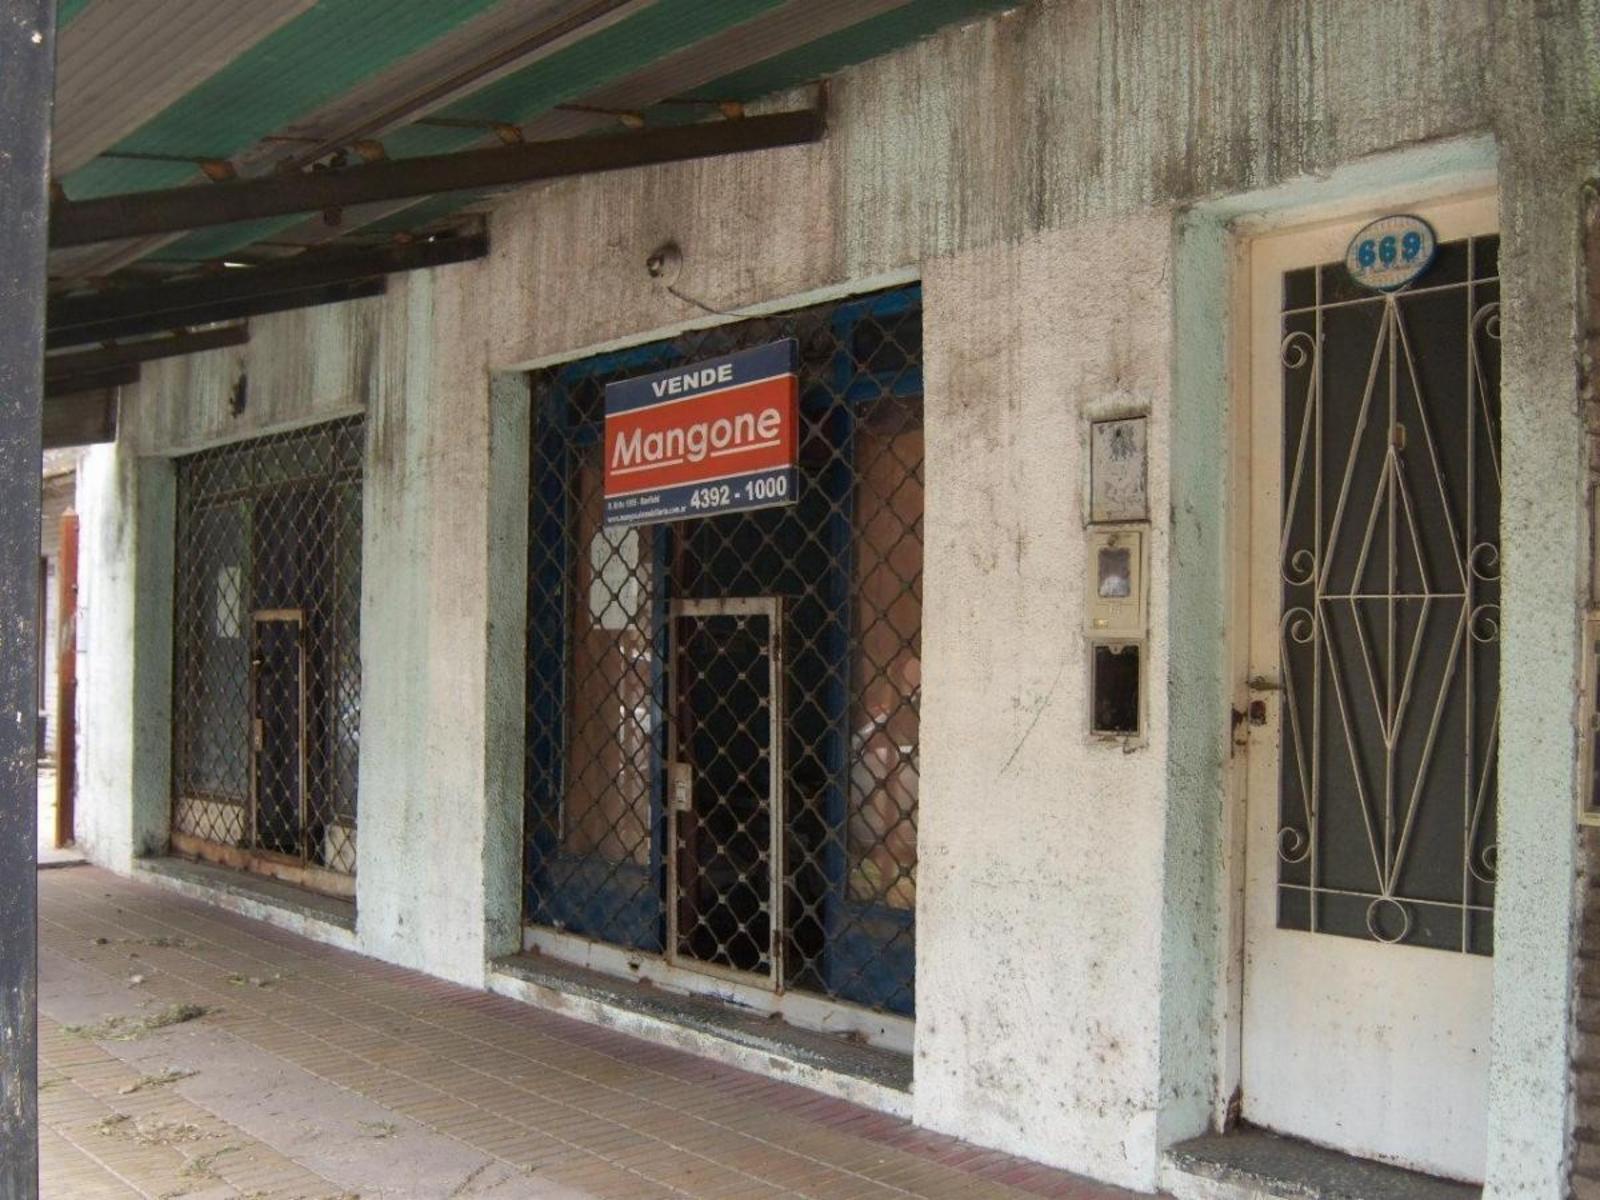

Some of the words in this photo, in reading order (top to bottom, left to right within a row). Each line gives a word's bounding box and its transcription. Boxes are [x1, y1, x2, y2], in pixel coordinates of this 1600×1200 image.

[1358, 231, 1421, 267] 669
[652, 364, 733, 397] VENDE
[611, 408, 781, 468] Mangone
[690, 485, 730, 509] 4392
[745, 475, 787, 501] 1000
